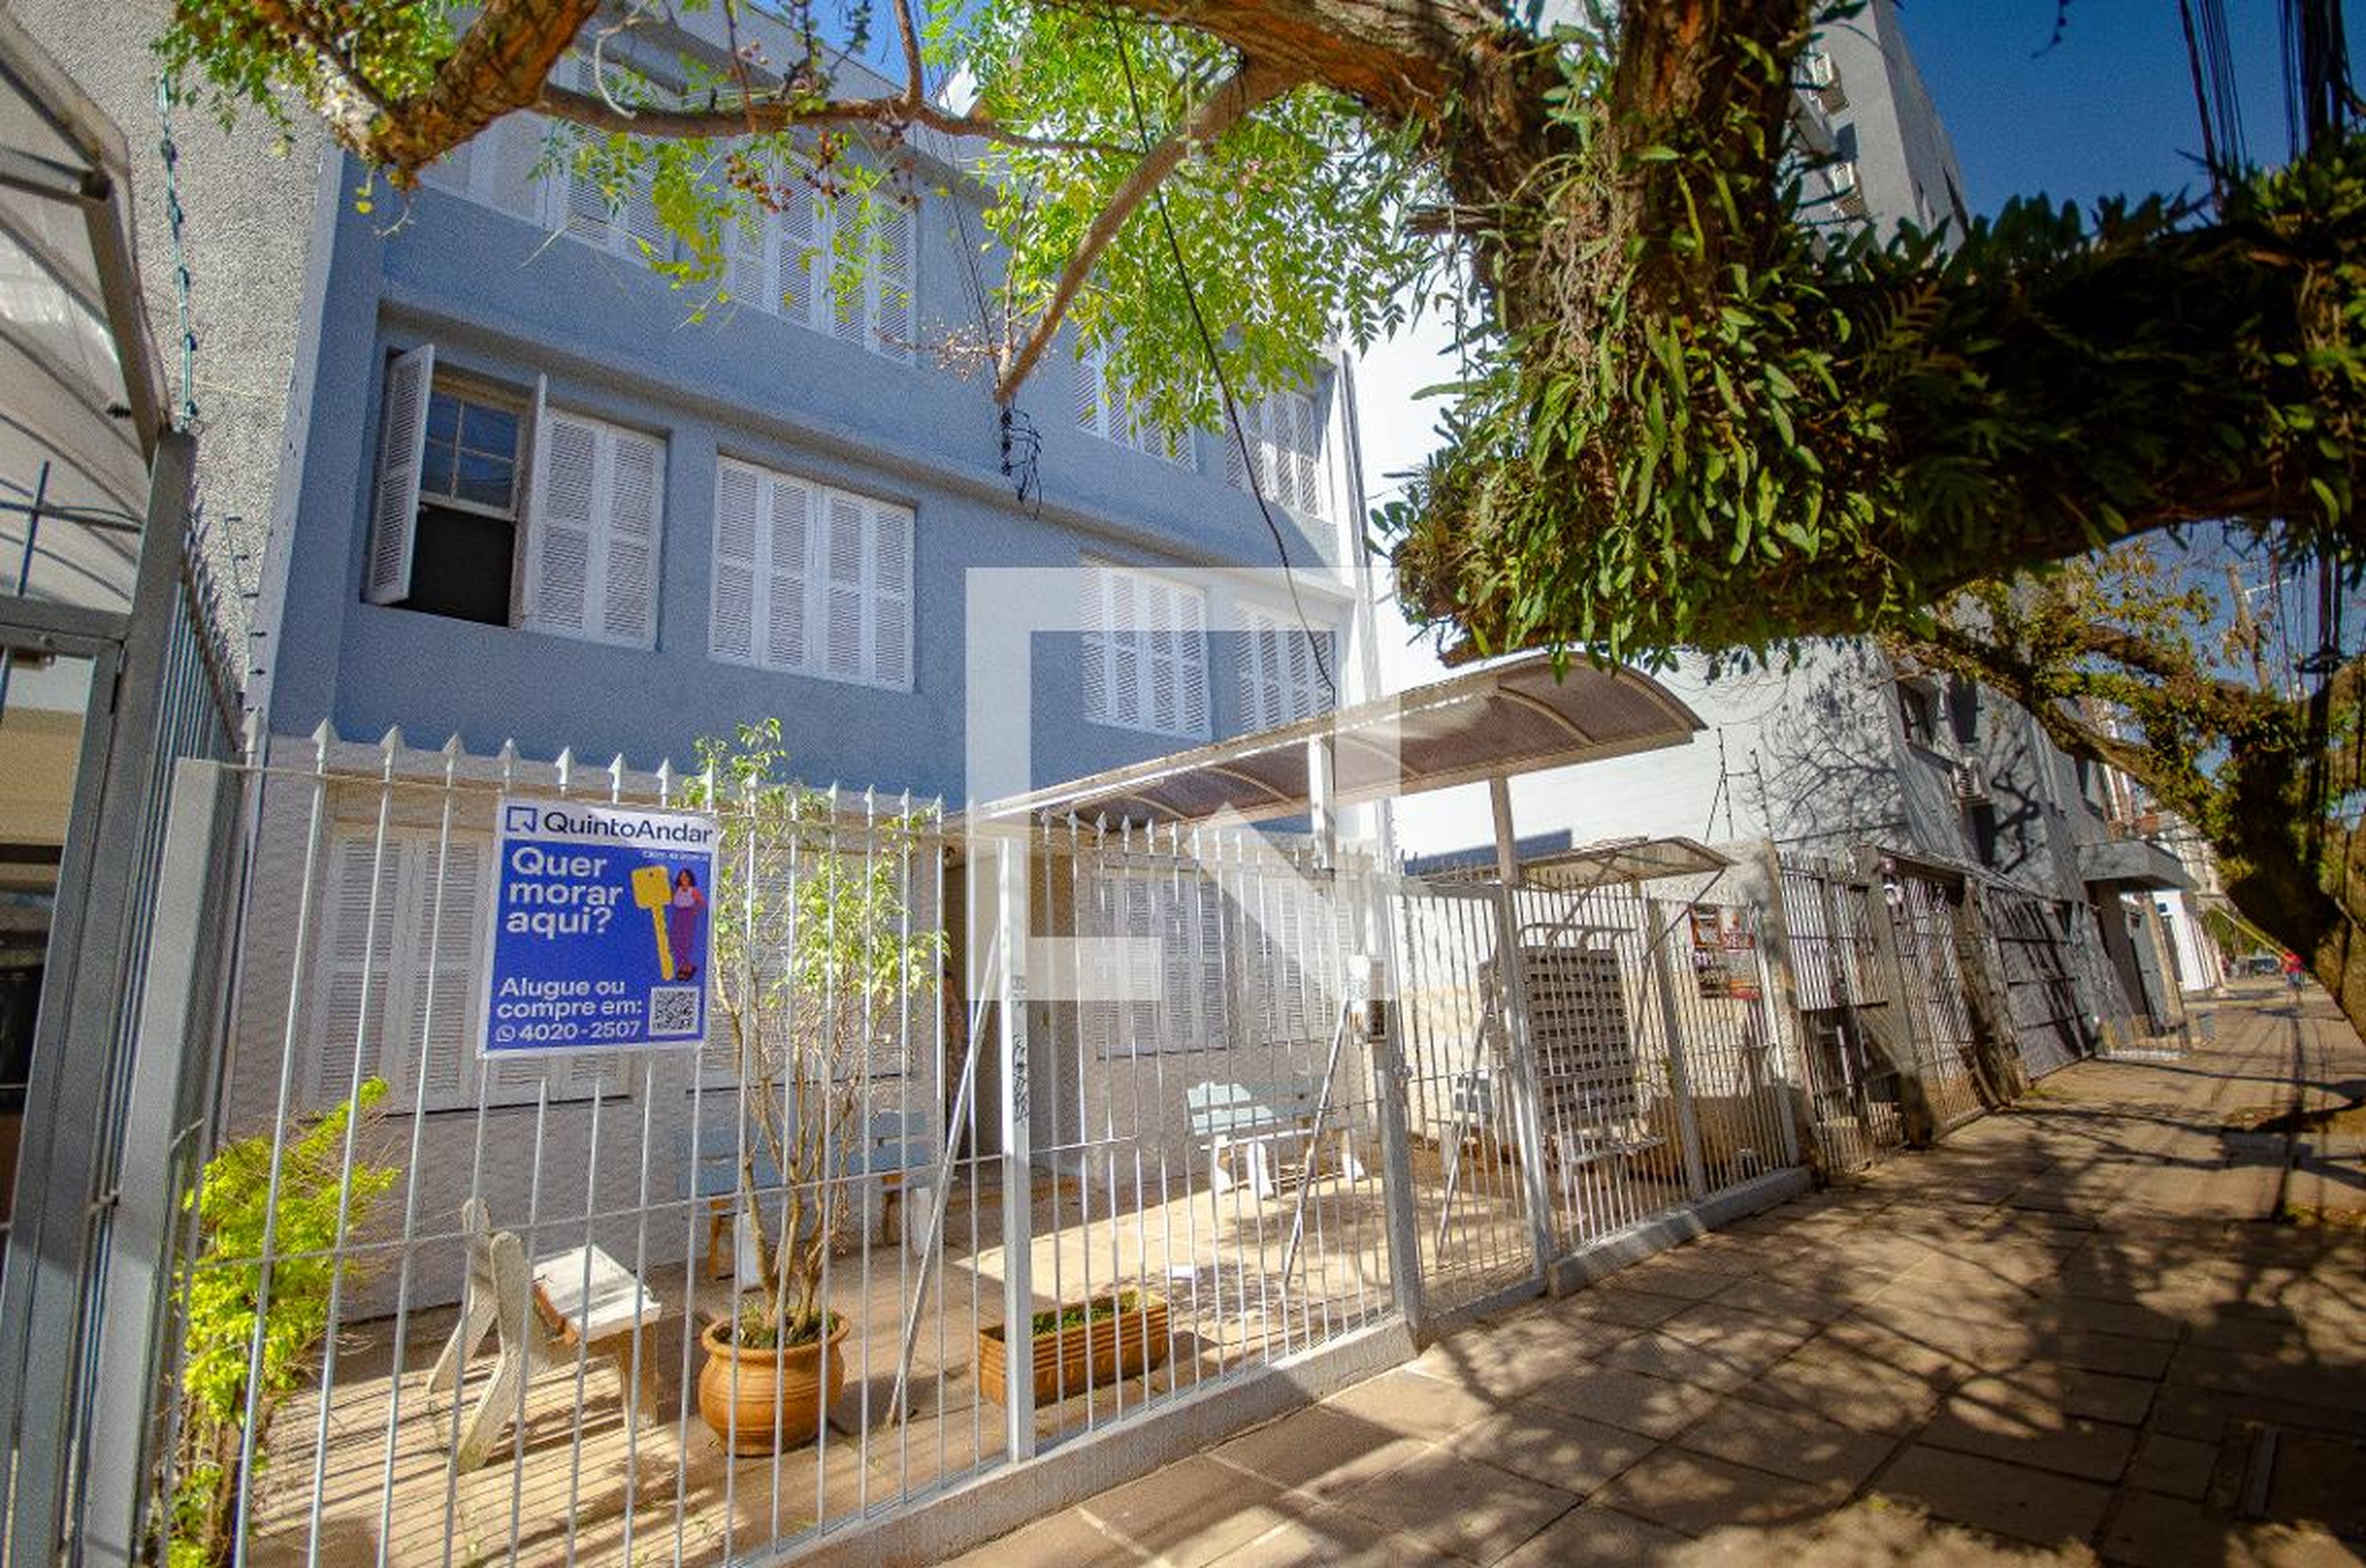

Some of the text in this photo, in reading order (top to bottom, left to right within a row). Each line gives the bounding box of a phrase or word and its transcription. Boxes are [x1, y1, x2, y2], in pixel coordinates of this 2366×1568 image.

[544, 811, 713, 843] QuintoAndar
[511, 847, 608, 877] Quer
[509, 882, 623, 906] morar
[506, 906, 613, 940] aqui?
[499, 977, 625, 1001] Alugue ou
[497, 999, 643, 1020] compre em:
